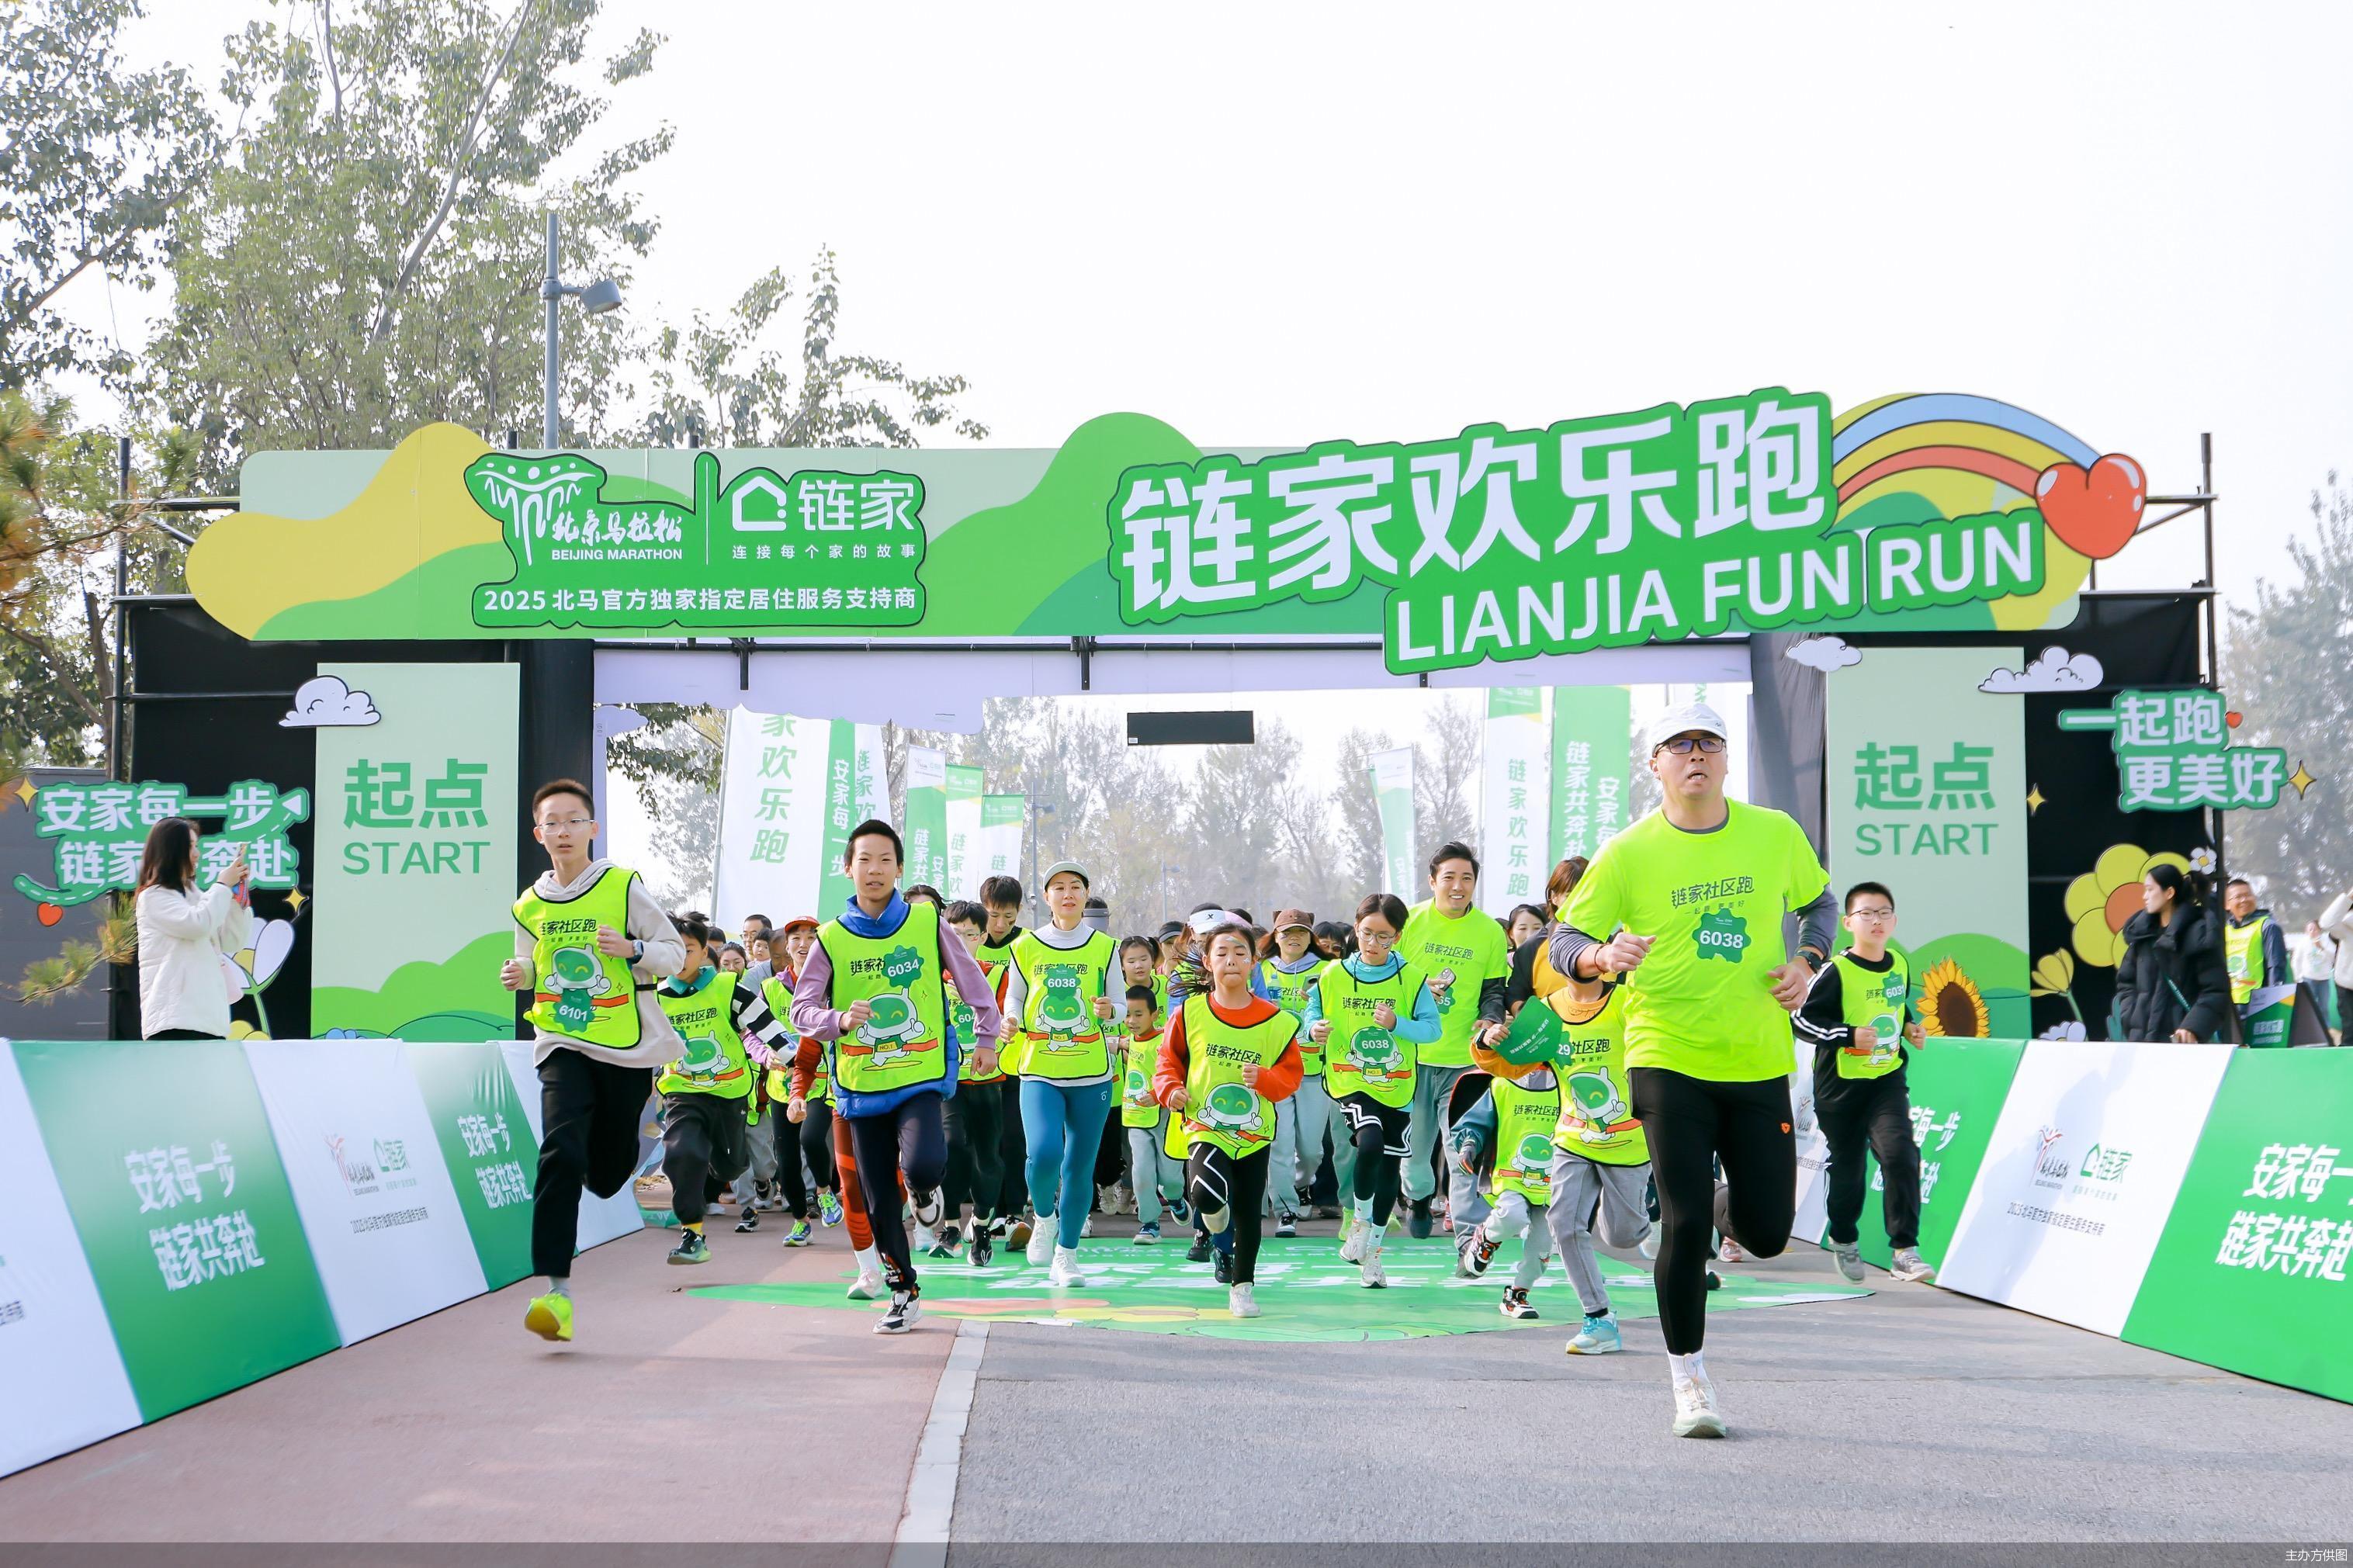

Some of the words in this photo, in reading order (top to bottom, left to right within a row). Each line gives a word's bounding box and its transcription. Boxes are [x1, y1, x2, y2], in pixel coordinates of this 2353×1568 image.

[799, 479, 914, 531] 链家
[1122, 400, 1824, 612] 链家欢乐跑
[552, 509, 681, 546] 北京马拉松
[552, 550, 604, 560] BEIJING
[608, 549, 682, 559] MARATHON
[733, 544, 915, 559] 连接每个家的故事
[484, 590, 544, 611] 2025
[552, 587, 915, 611] 北马官方独家指定居住服务支持商
[1400, 580, 1676, 661] LIANJIA
[1704, 545, 1851, 616] FUN
[1879, 523, 2032, 600] RUN
[2067, 697, 2222, 746] 一起跑
[344, 759, 488, 829] 起点
[1854, 742, 1996, 811] 起点
[2126, 755, 2282, 805] 更美好
[41, 788, 272, 832] 安家每一步
[1506, 758, 1529, 897] 链家欢乐跑
[342, 842, 490, 874] START
[1856, 822, 1998, 856] START
[61, 841, 293, 885] 链家奔赴
[1672, 875, 1755, 909] 链家社区跑
[1425, 943, 1473, 959] 链家社区跑
[1700, 930, 1744, 949] 6038
[888, 959, 919, 977] 6034
[1048, 978, 1076, 988] 6038
[559, 1006, 587, 1021] 6101
[1362, 1040, 1389, 1049] 6038
[457, 1113, 510, 1158] 安家每一步
[124, 1139, 234, 1214] 安家每一步
[475, 1161, 532, 1210] 链家共奔赴
[2242, 1143, 2353, 1206] 安家每一
[149, 1210, 265, 1292] 链家共奔赴
[2215, 1210, 2353, 1281] 链家共奔赴
